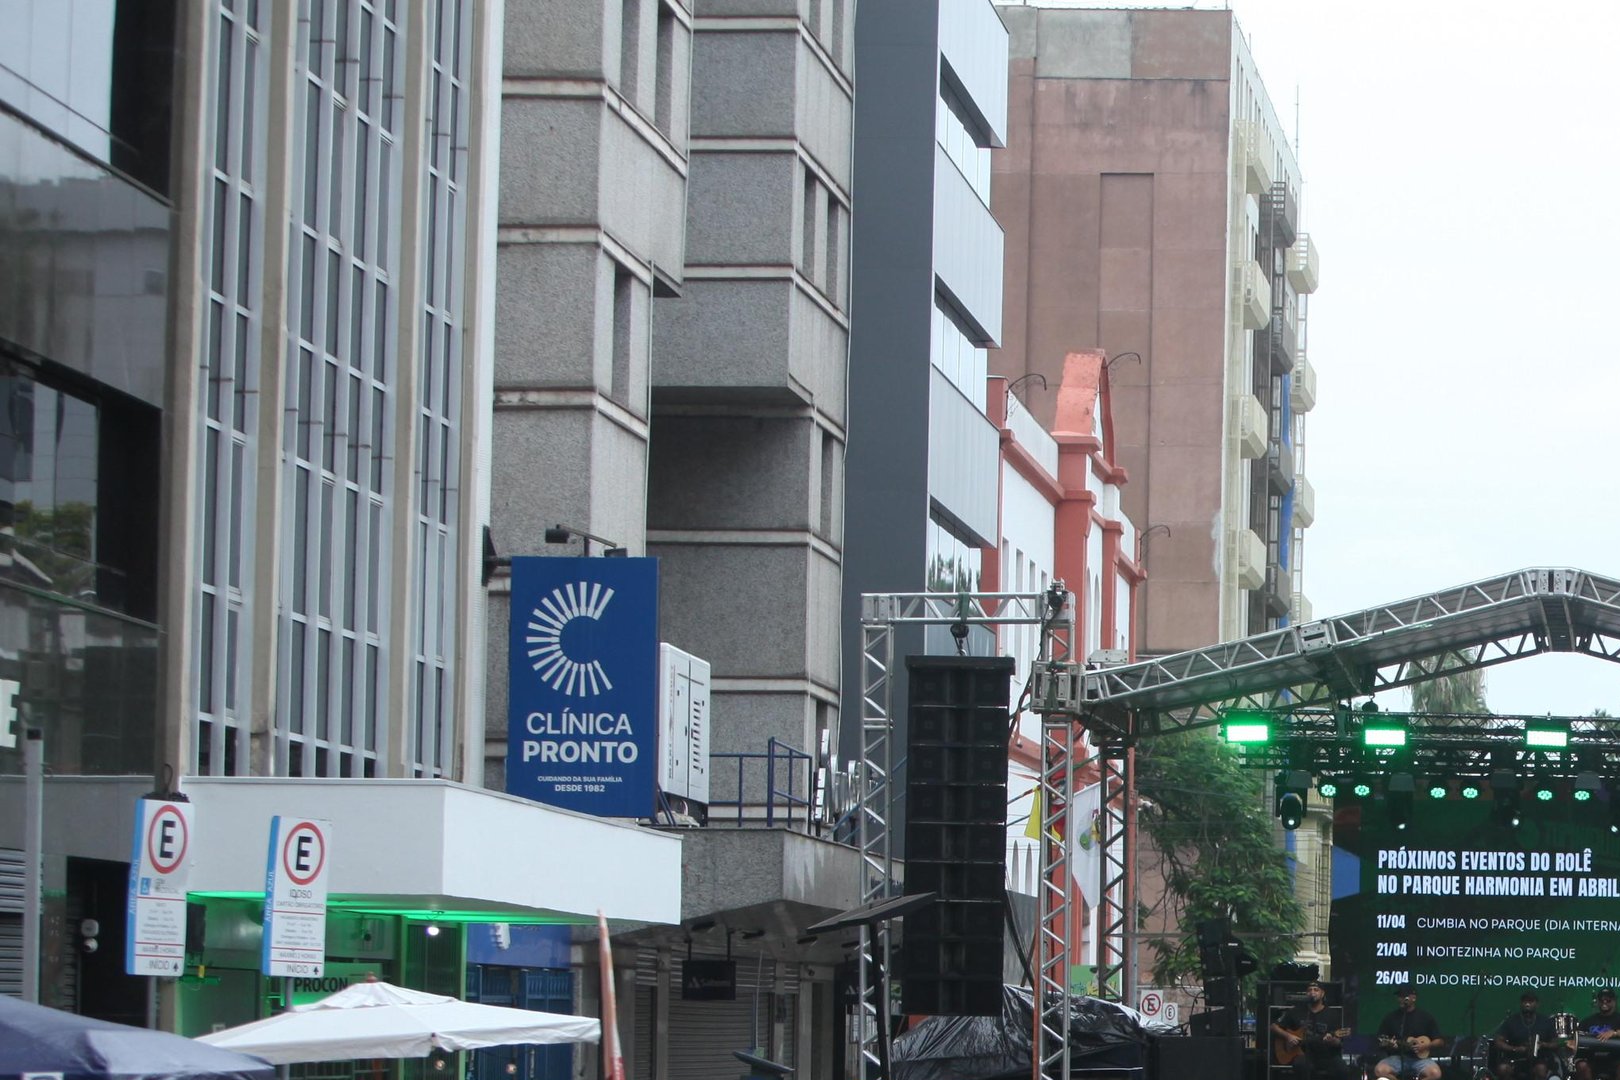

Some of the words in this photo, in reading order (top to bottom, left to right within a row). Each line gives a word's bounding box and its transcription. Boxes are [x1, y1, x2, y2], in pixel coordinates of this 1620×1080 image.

[526, 707, 633, 735] CLÍNICA
[523, 740, 638, 764] PRONTO
[584, 785, 605, 793] 1982
[597, 775, 623, 783] FAMÍLIA
[159, 820, 176, 859] E
[295, 835, 313, 872] E
[1378, 845, 1456, 870] PRÓXIMOS
[1461, 851, 1525, 871] EVENTOS
[1530, 853, 1550, 872] DO
[1556, 848, 1592, 872] ROLÊ
[1377, 875, 1398, 894] NO
[1403, 875, 1460, 896] PARQUE
[1465, 876, 1545, 896] HARMONIA
[1550, 877, 1573, 897] EM
[1376, 914, 1406, 929] 11/04
[1416, 918, 1467, 929] CUMBIA
[1469, 918, 1489, 930] NO
[1491, 919, 1541, 932] PARQUE
[1544, 919, 1570, 932] (DIA
[1376, 942, 1407, 957] 21/04
[1416, 946, 1423, 957] II
[1426, 946, 1501, 958] NOITEZINHA
[1504, 947, 1524, 958] NO
[1526, 948, 1576, 961] PARQUE
[294, 977, 349, 993] PROCON
[1376, 971, 1409, 985] 26/04
[1416, 974, 1437, 985] DIA
[1440, 974, 1459, 985] DO
[1461, 975, 1480, 986] REI
[1484, 975, 1503, 986] NO
[1505, 975, 1555, 988] PARQUE
